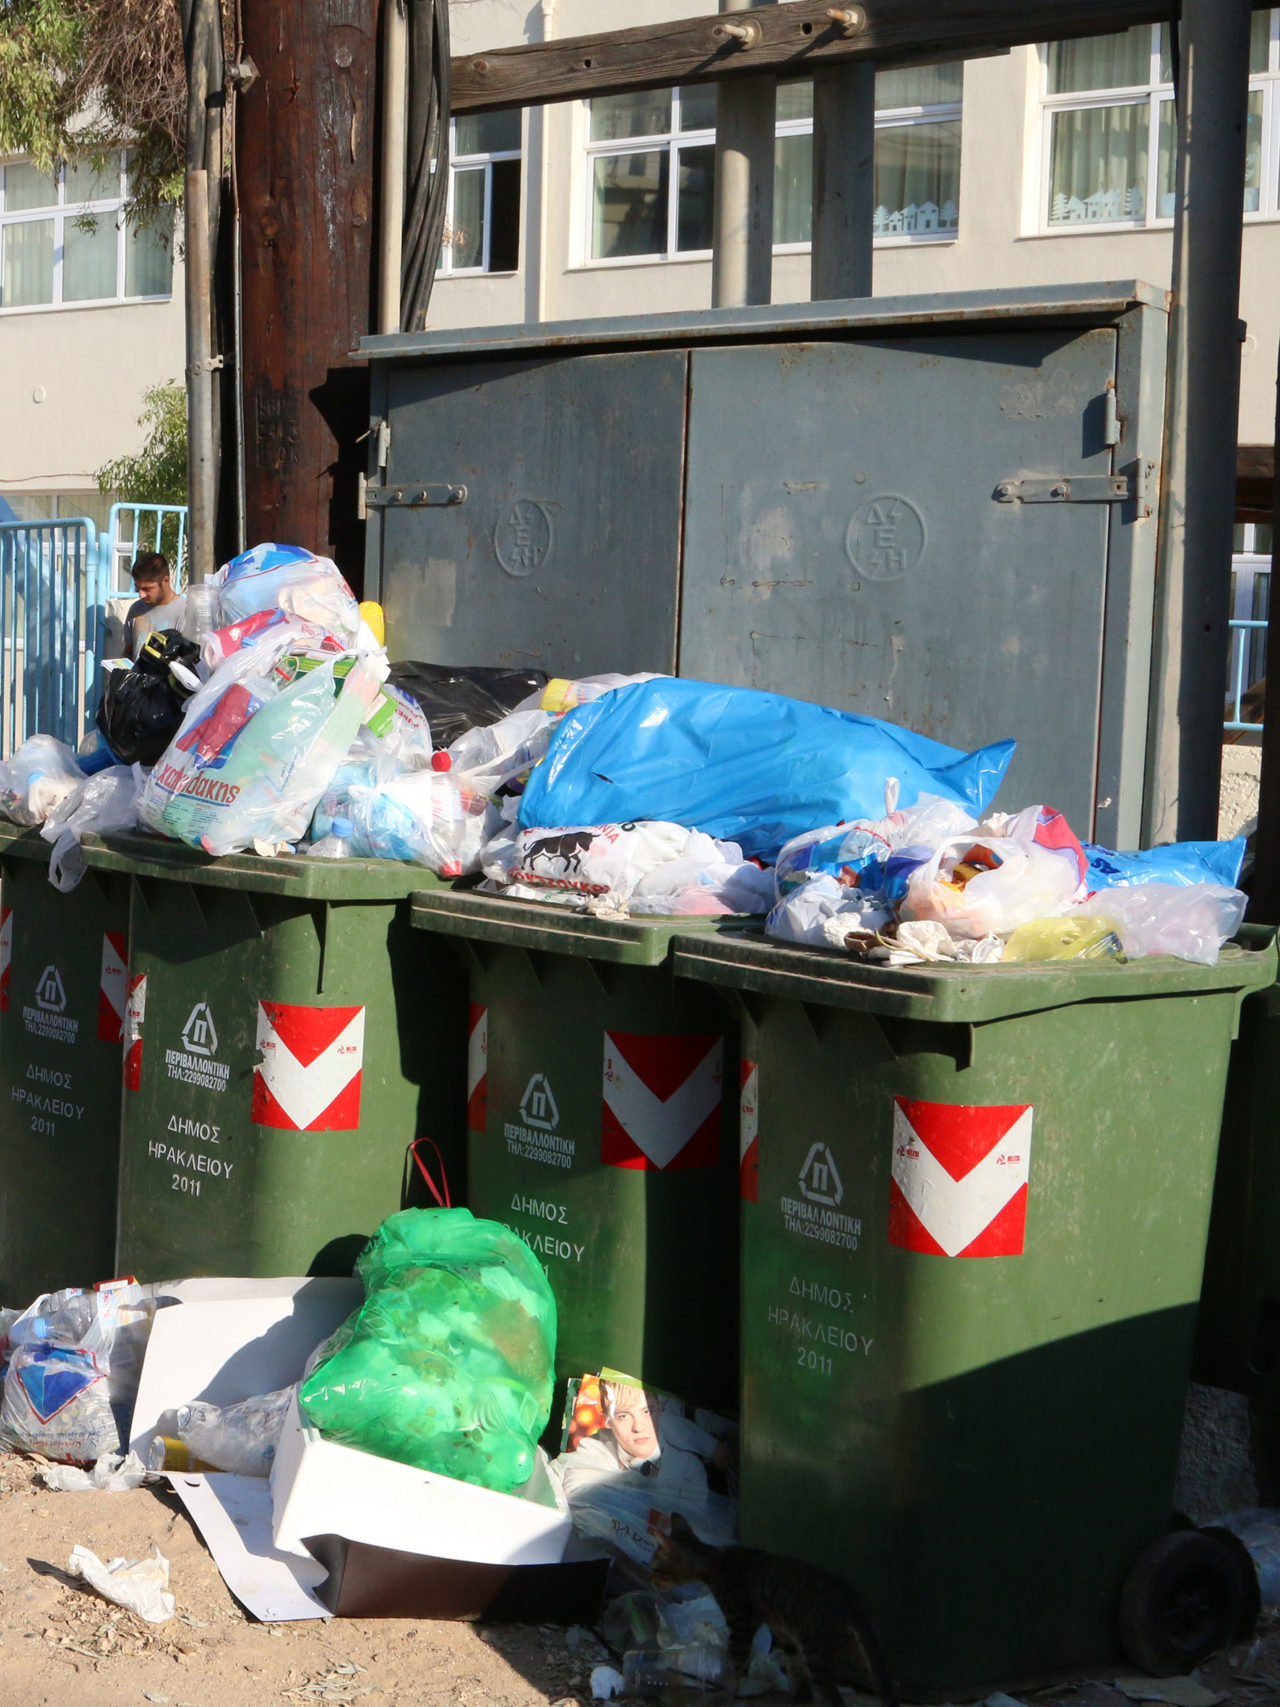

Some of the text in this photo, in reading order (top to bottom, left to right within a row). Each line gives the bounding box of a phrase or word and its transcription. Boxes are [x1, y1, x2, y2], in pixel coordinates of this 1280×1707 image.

[23, 1006, 79, 1033] ΠΕΡΙΒΑΛΛΟΝΤΙΚΗ
[26, 1064, 73, 1090] ΔΗΜΟΣ
[165, 1049, 230, 1080] ΠΕΡΙΒΑΛΛΟΝΤΙΚΗ
[167, 1064, 226, 1092] ΤΗΛ:2299082700
[11, 1086, 85, 1121] ΗΡΑΚΛΕΙΟΥ
[31, 1115, 56, 1137] 2011
[168, 1115, 221, 1144] ΔΗΜΟΣ
[504, 1122, 575, 1155] ΠΕΡΙΒΑΛΛΟΝΤΙΚΗ
[148, 1140, 234, 1180] ΗΡΑΚΛΕΙΟΥ
[506, 1139, 572, 1169] ΤΗΛ:2299082700
[172, 1174, 202, 1197] 2011
[511, 1193, 568, 1225] ΔΗΜΟΣ
[781, 1196, 862, 1236] ΠΕΡΙΒΑΛΛΟΝΤΙΚΗ
[784, 1215, 858, 1251] ΤΗΛ:2299082700
[789, 1275, 854, 1313] ΔΗΜΟΣ
[768, 1305, 873, 1356] ΗΡΑΚΛΕΙΟΥ
[798, 1347, 833, 1376] 2011
